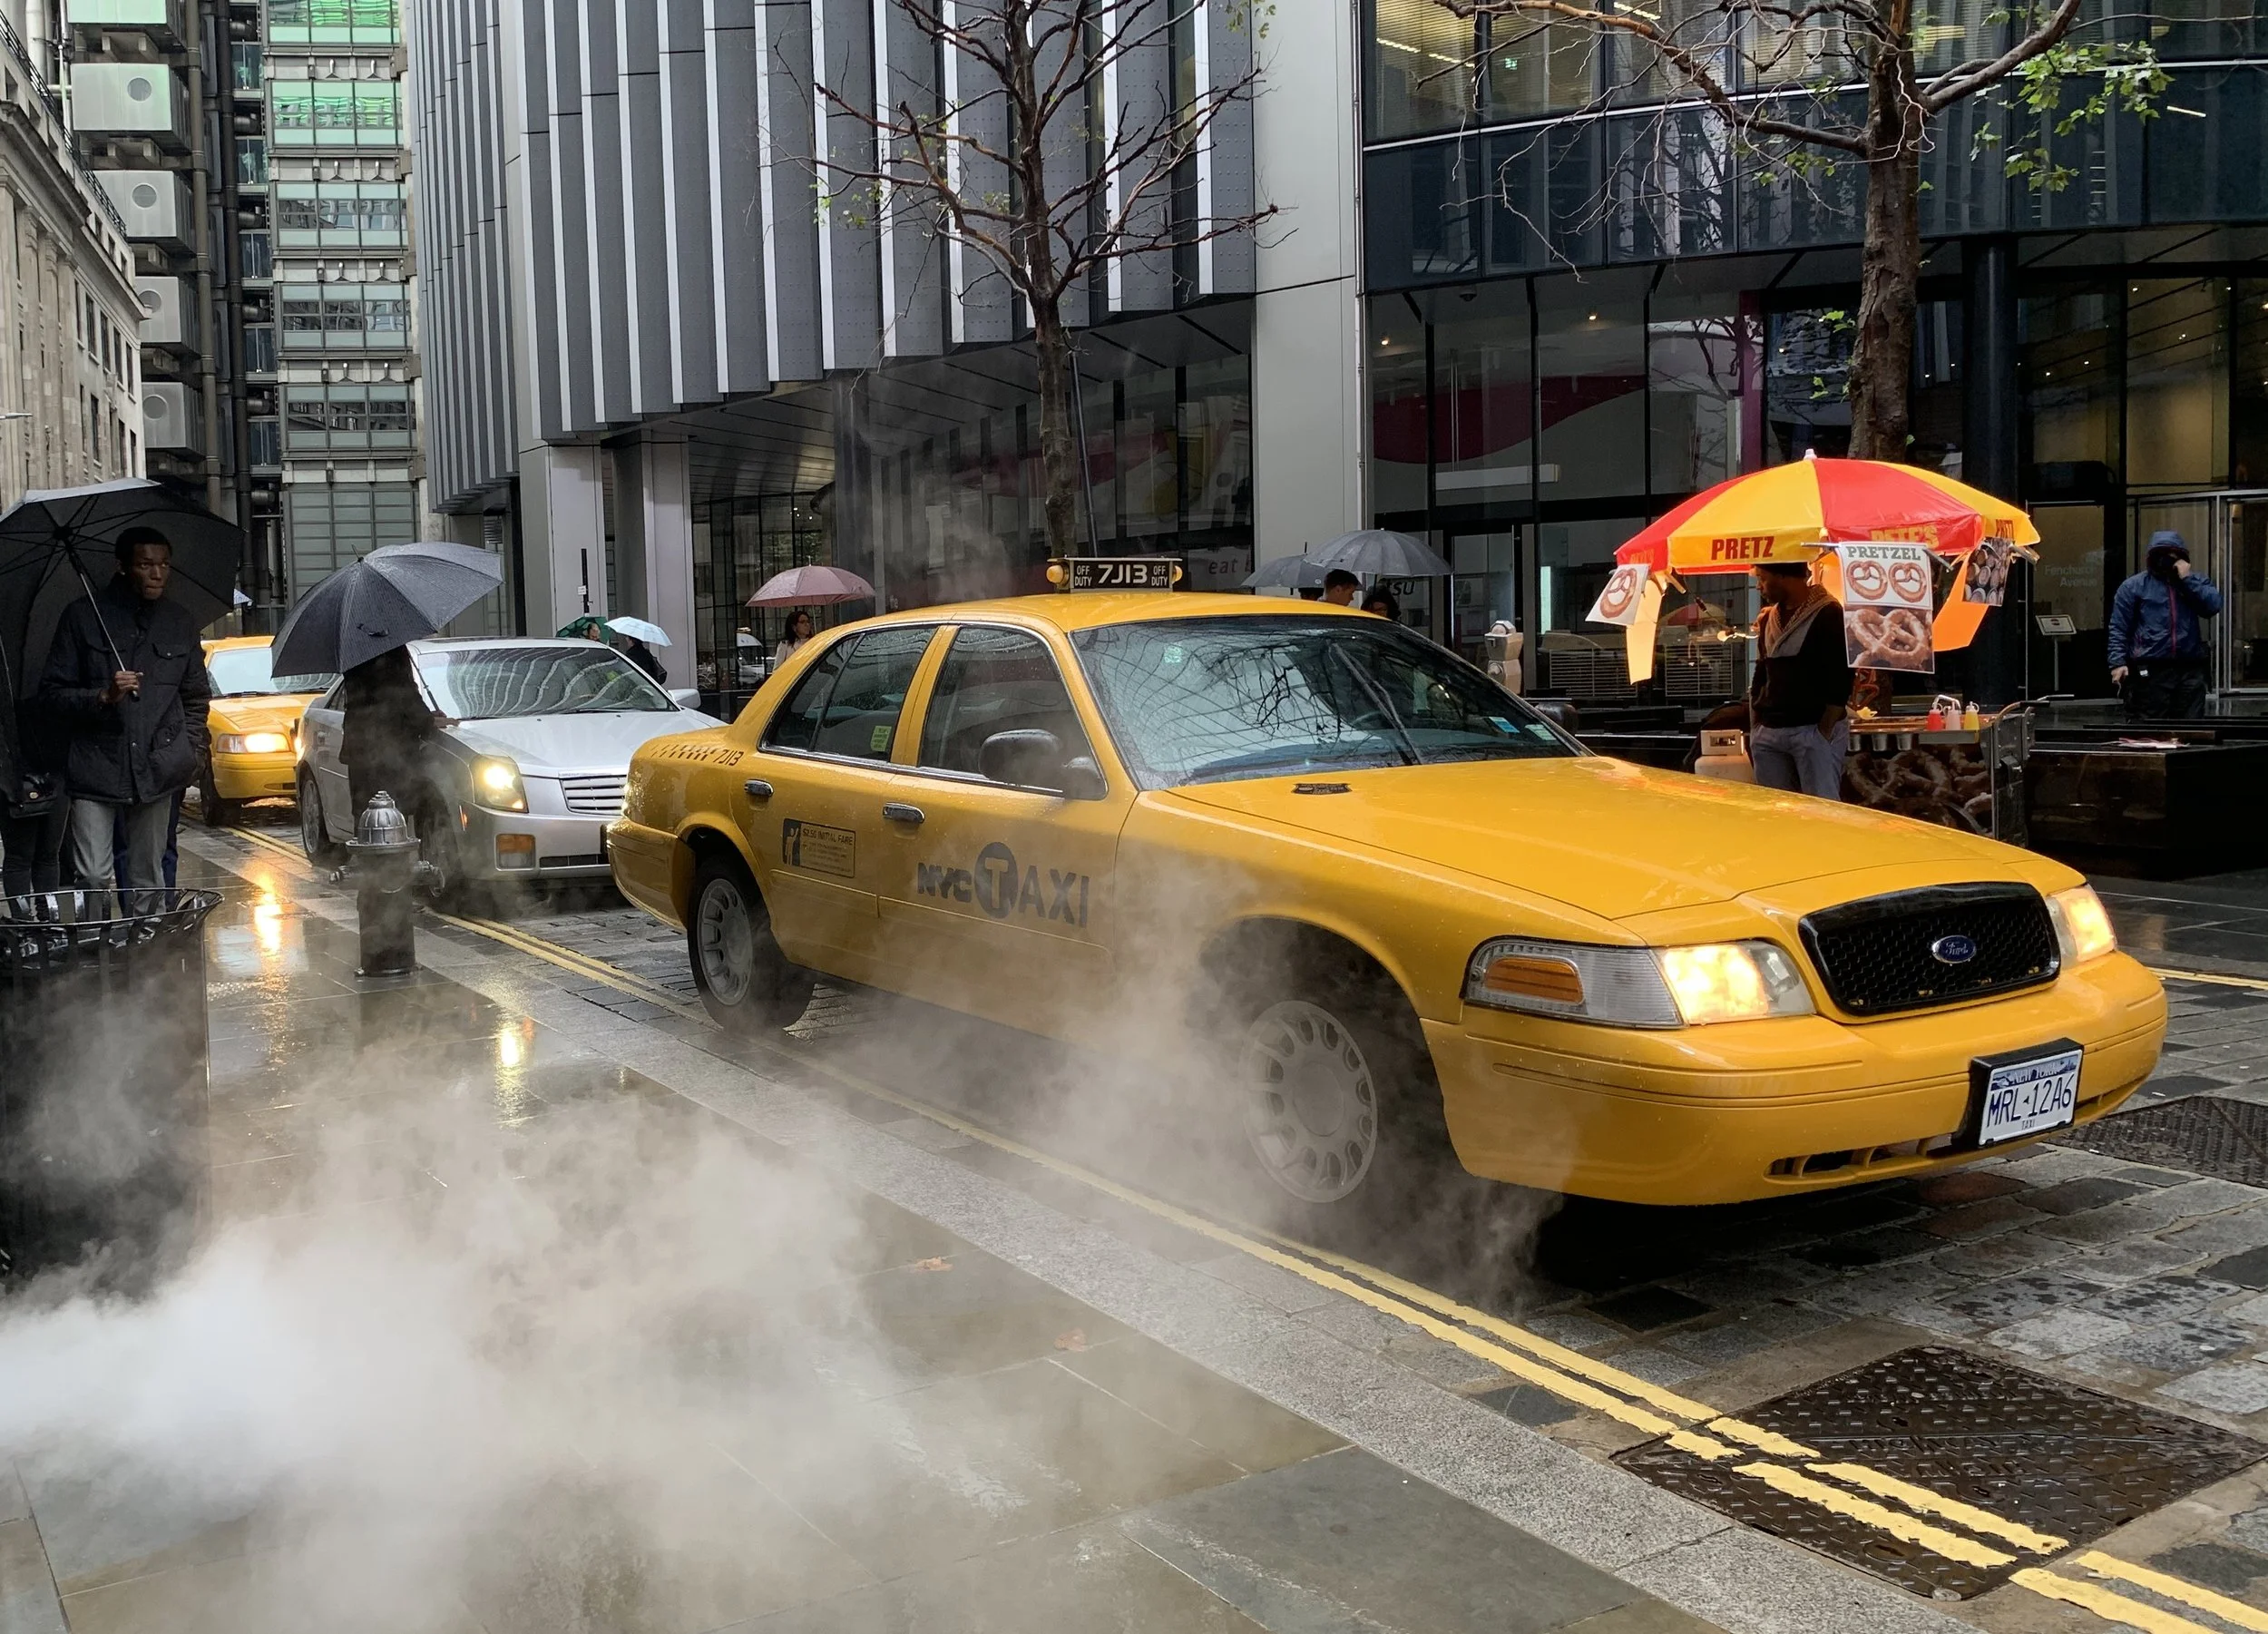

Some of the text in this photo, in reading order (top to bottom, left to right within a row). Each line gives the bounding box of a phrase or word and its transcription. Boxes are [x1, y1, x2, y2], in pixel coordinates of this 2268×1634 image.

[1710, 536, 1775, 560] PRETZ
[1846, 546, 1921, 561] PRETZEL
[1076, 565, 1090, 575] OFF
[1153, 565, 1166, 575] OFF
[1208, 558, 1237, 574] eat
[1098, 563, 1148, 583] 7J13
[1074, 576, 1092, 587] DUTY
[1151, 576, 1168, 587] DUTY
[837, 835, 853, 846] FARE
[2021, 1119, 2036, 1130] TAXI
